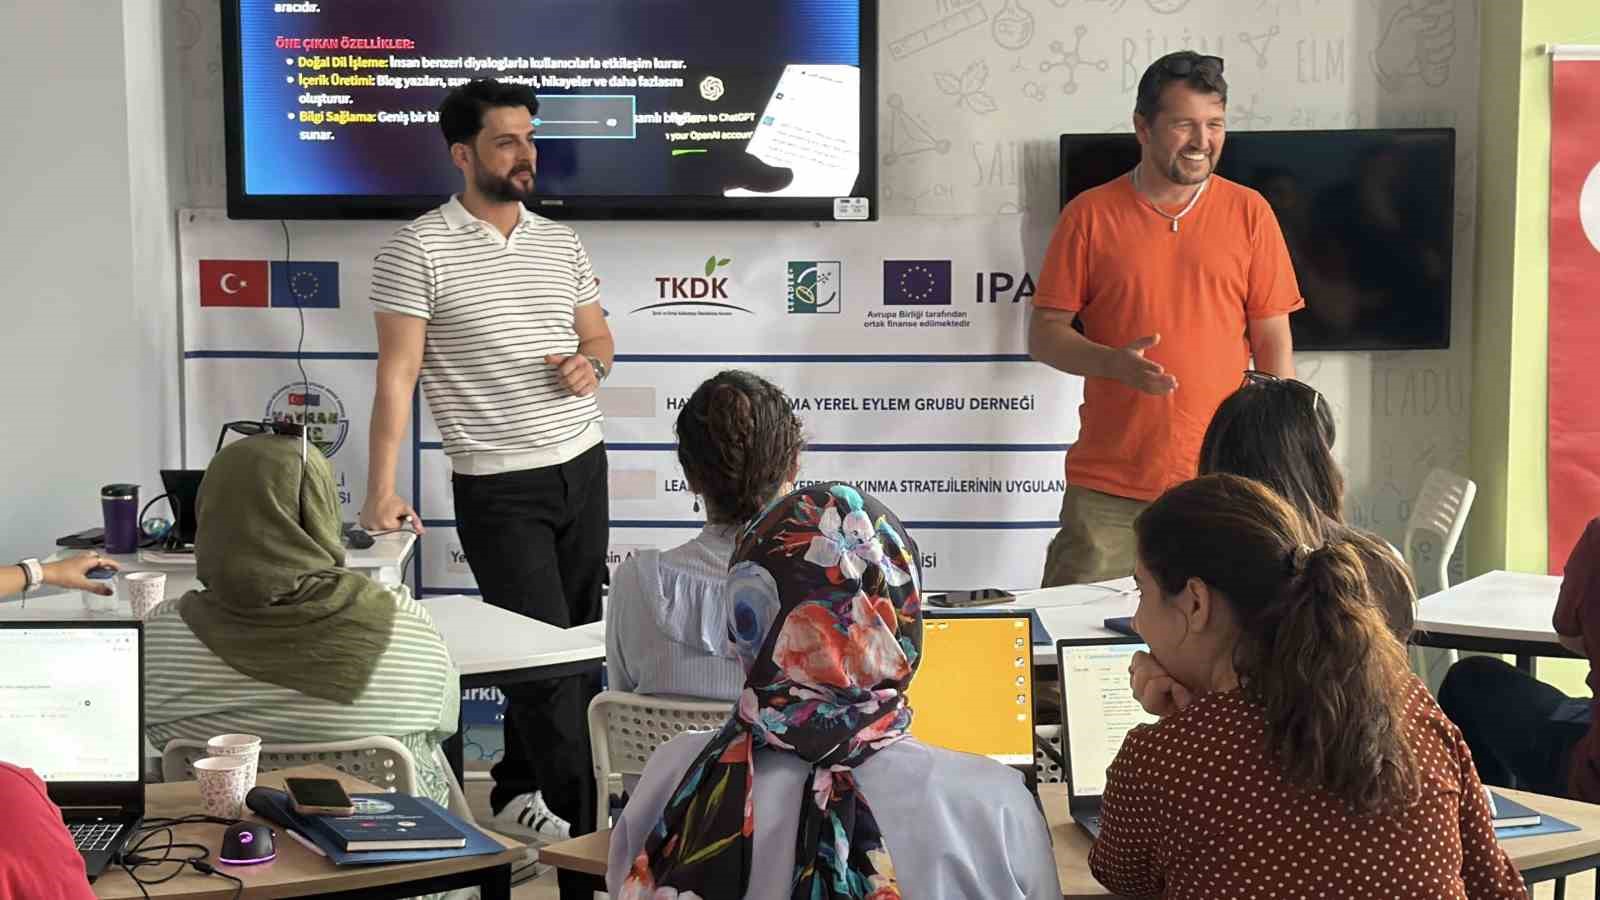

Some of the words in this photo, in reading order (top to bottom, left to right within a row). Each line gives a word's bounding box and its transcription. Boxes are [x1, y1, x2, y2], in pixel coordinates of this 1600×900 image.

[276, 36, 301, 48] ÖNE
[303, 37, 338, 51] ÇIKAN
[341, 36, 415, 48] ÖZELLİKLER:
[298, 56, 330, 70] Doğal
[332, 57, 347, 67] Dil
[349, 55, 388, 70] İşleme:
[389, 56, 420, 68] İnsan
[421, 57, 463, 68] benzeri
[602, 57, 652, 72] etkileşim
[654, 58, 687, 69] kurar.
[298, 73, 329, 88] İçerik
[331, 73, 375, 86] Üretimi:
[377, 75, 403, 88] Blog
[542, 76, 593, 89] hikayeler
[594, 79, 607, 87] ve
[609, 76, 636, 87] daha
[299, 93, 353, 107] oluşturur.
[300, 111, 324, 124] Bilgi
[326, 111, 376, 124] Sağlama:
[378, 111, 409, 125] Geniş
[410, 112, 427, 123] bir
[428, 111, 439, 123] bi
[300, 130, 335, 140] sunar.
[655, 277, 728, 298] TKDK
[867, 311, 897, 320] Avrupa
[864, 320, 884, 328] ortak
[814, 397, 858, 410] YEREL
[863, 397, 910, 411] EYLEM
[915, 397, 965, 411] GRUBU
[970, 395, 1035, 411] DERNEĞİ
[900, 476, 1001, 493] STRATEJİLERİNİN
